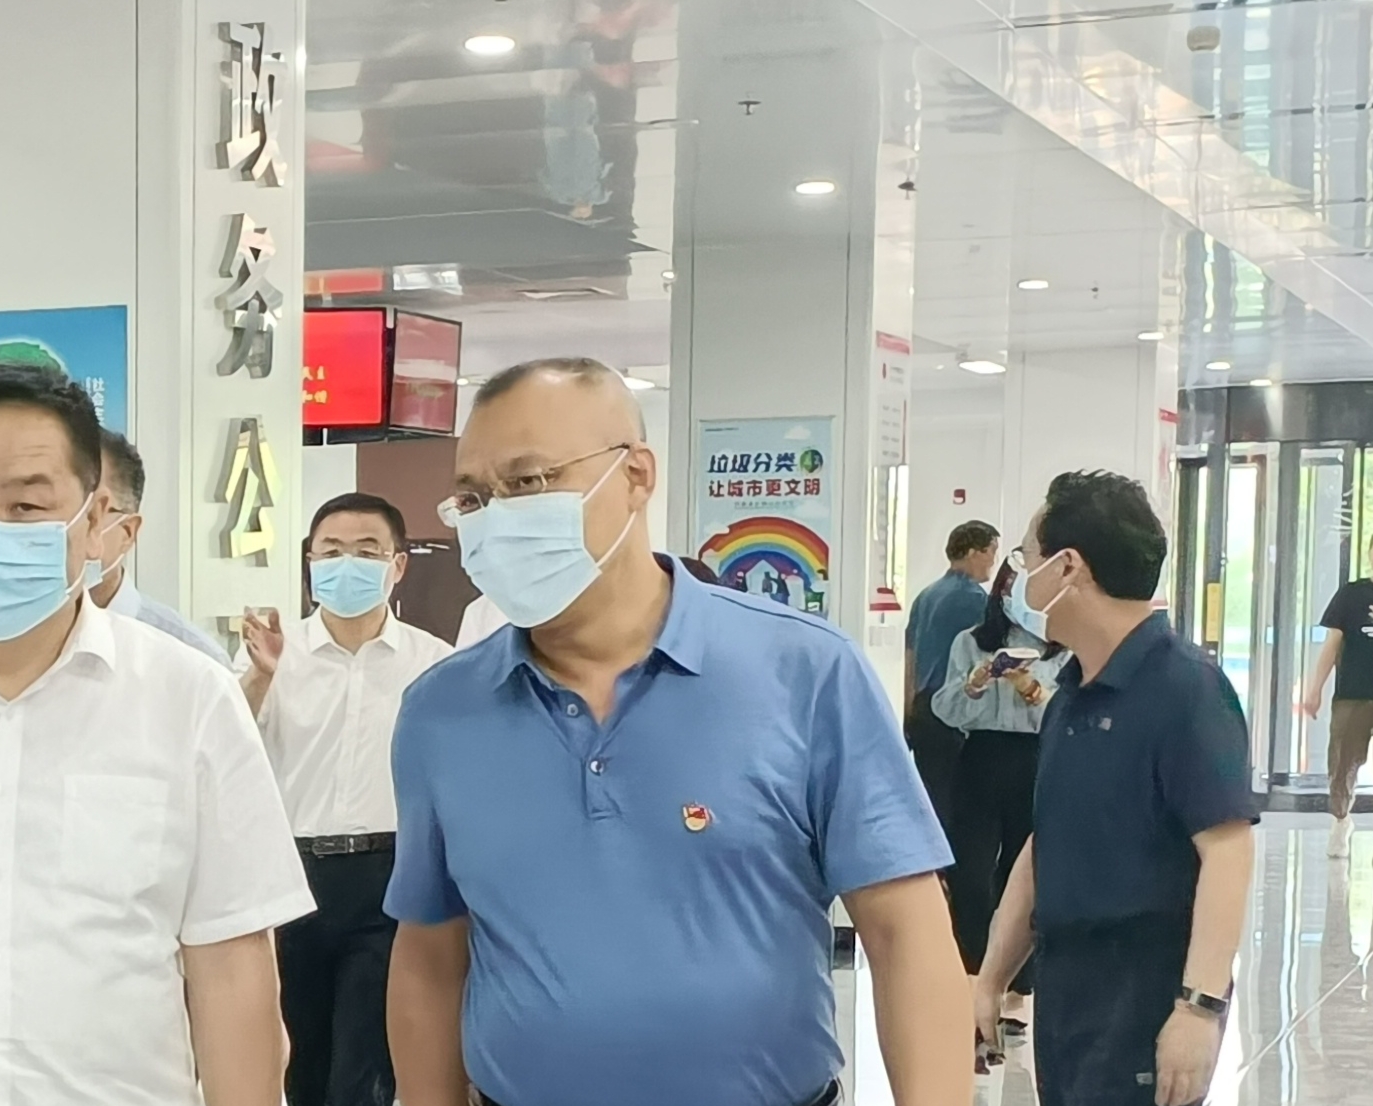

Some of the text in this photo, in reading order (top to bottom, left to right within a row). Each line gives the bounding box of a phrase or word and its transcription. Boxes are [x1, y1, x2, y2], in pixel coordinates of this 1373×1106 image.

[707, 451, 798, 474] 垃圾分类
[708, 477, 821, 498] 让城市更文明
